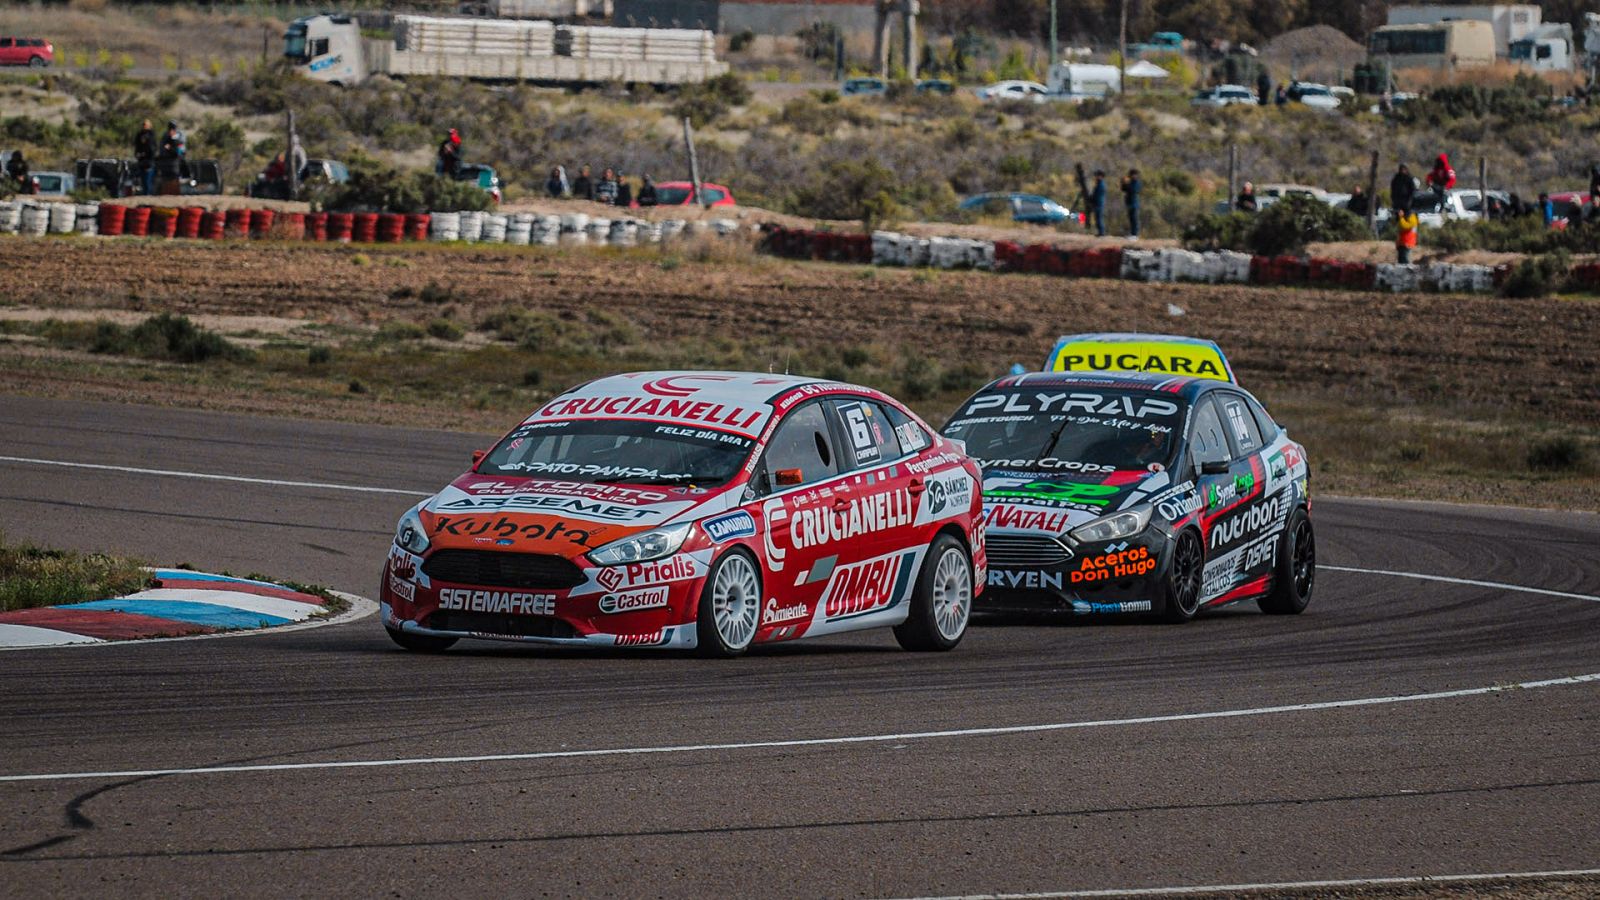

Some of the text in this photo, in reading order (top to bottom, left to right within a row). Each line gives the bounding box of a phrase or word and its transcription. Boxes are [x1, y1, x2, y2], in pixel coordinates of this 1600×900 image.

[1063, 354, 1220, 376] PUCARA
[541, 397, 762, 428] CRUCIANELLI
[965, 393, 1178, 418] PLYRAP
[655, 426, 695, 437] FELIZ
[695, 430, 718, 441] DÍA
[720, 435, 742, 445] MA
[846, 408, 870, 448] 6
[469, 480, 668, 501] EL TORITO
[982, 496, 1054, 506] eneral
[442, 496, 661, 519] ARSEMET
[790, 487, 912, 549] CRUCIANELLI
[985, 505, 1069, 533] NATALI
[435, 517, 590, 545] Kubota
[1211, 497, 1278, 549] nutribon
[403, 531, 412, 543] 6
[625, 554, 695, 585] Prialis
[1071, 559, 1155, 583] Don Hugo
[1081, 546, 1148, 571] Aceros
[825, 554, 901, 617] OMBU
[988, 569, 1062, 590] RVEN
[438, 588, 556, 615] SISTEMAFREE
[617, 589, 664, 609] Castrol
[614, 630, 662, 646] OMBU
